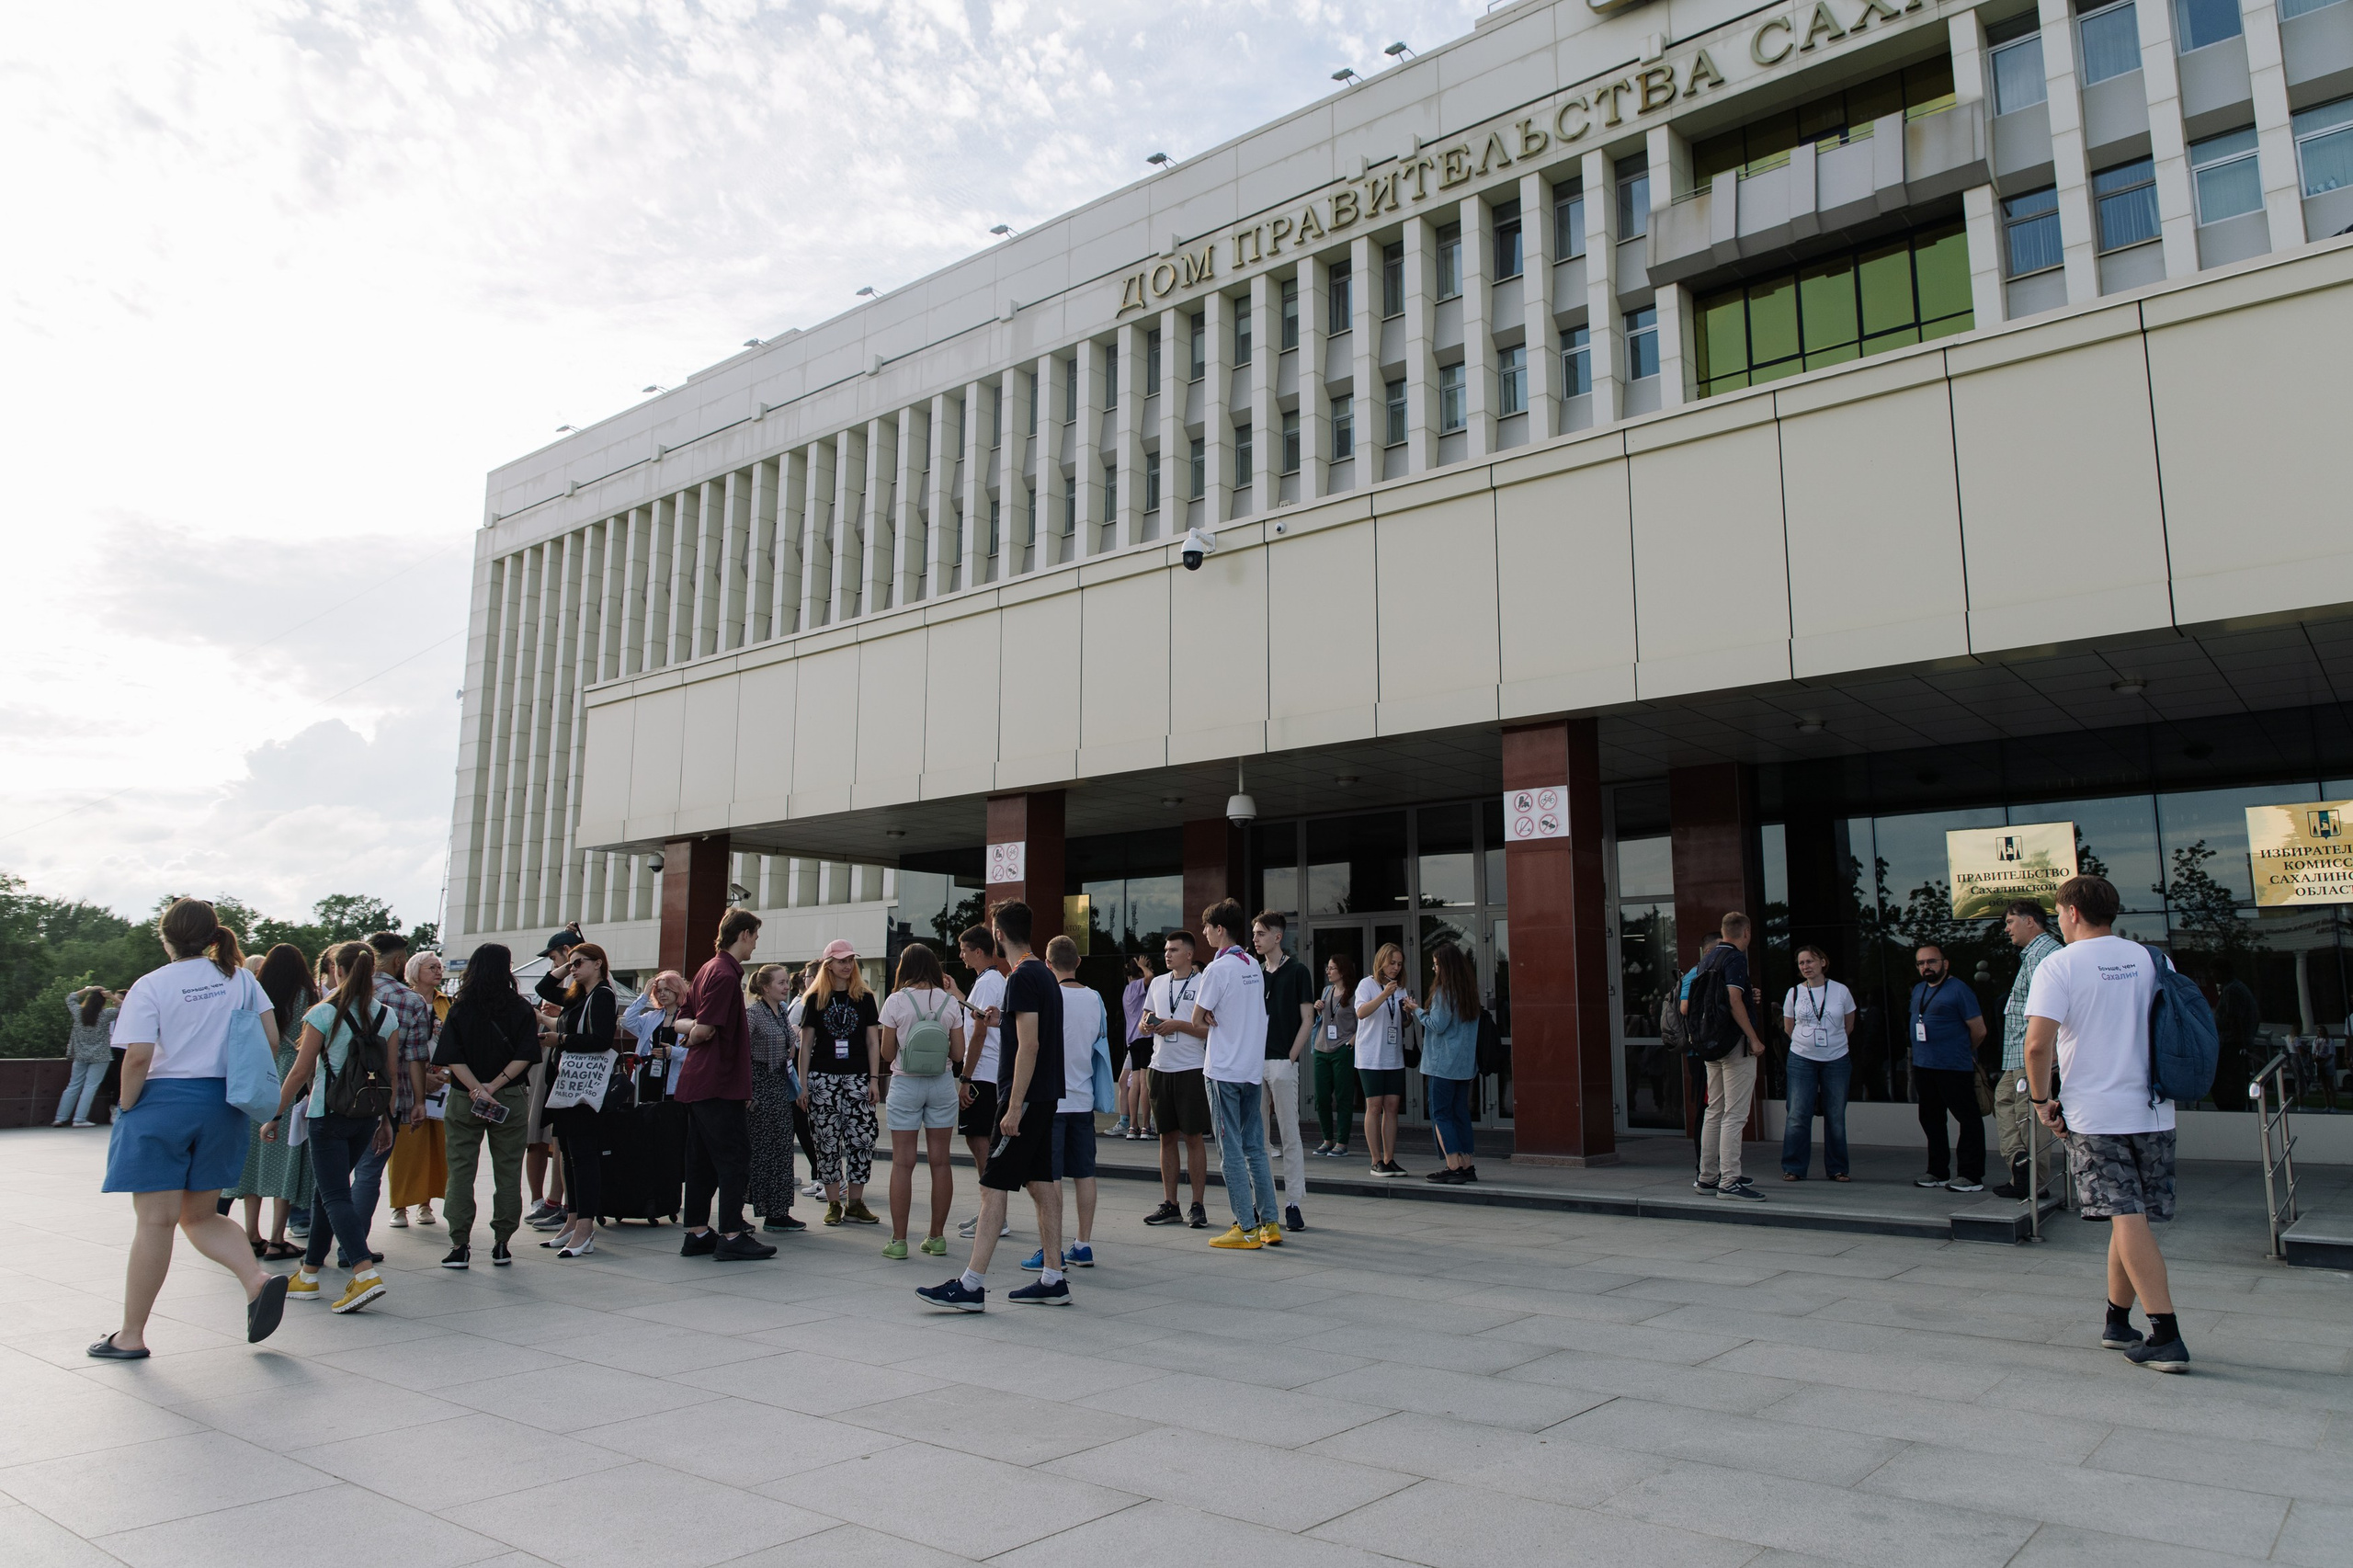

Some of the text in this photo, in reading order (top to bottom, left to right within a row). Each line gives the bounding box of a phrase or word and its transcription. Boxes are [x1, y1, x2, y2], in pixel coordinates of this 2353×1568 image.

[1115, 0, 1923, 319] ДОМ ПРАВИТЕЛЬСТВА САХ
[1957, 868, 2070, 883] ПРАВИТЕЛЬСТВО
[1970, 881, 2058, 895] Сахалинской
[2101, 971, 2139, 981] Сахалин
[184, 989, 226, 1003] Сахалин
[562, 1061, 607, 1073] YOU CAN
[556, 1079, 566, 1090] IS
